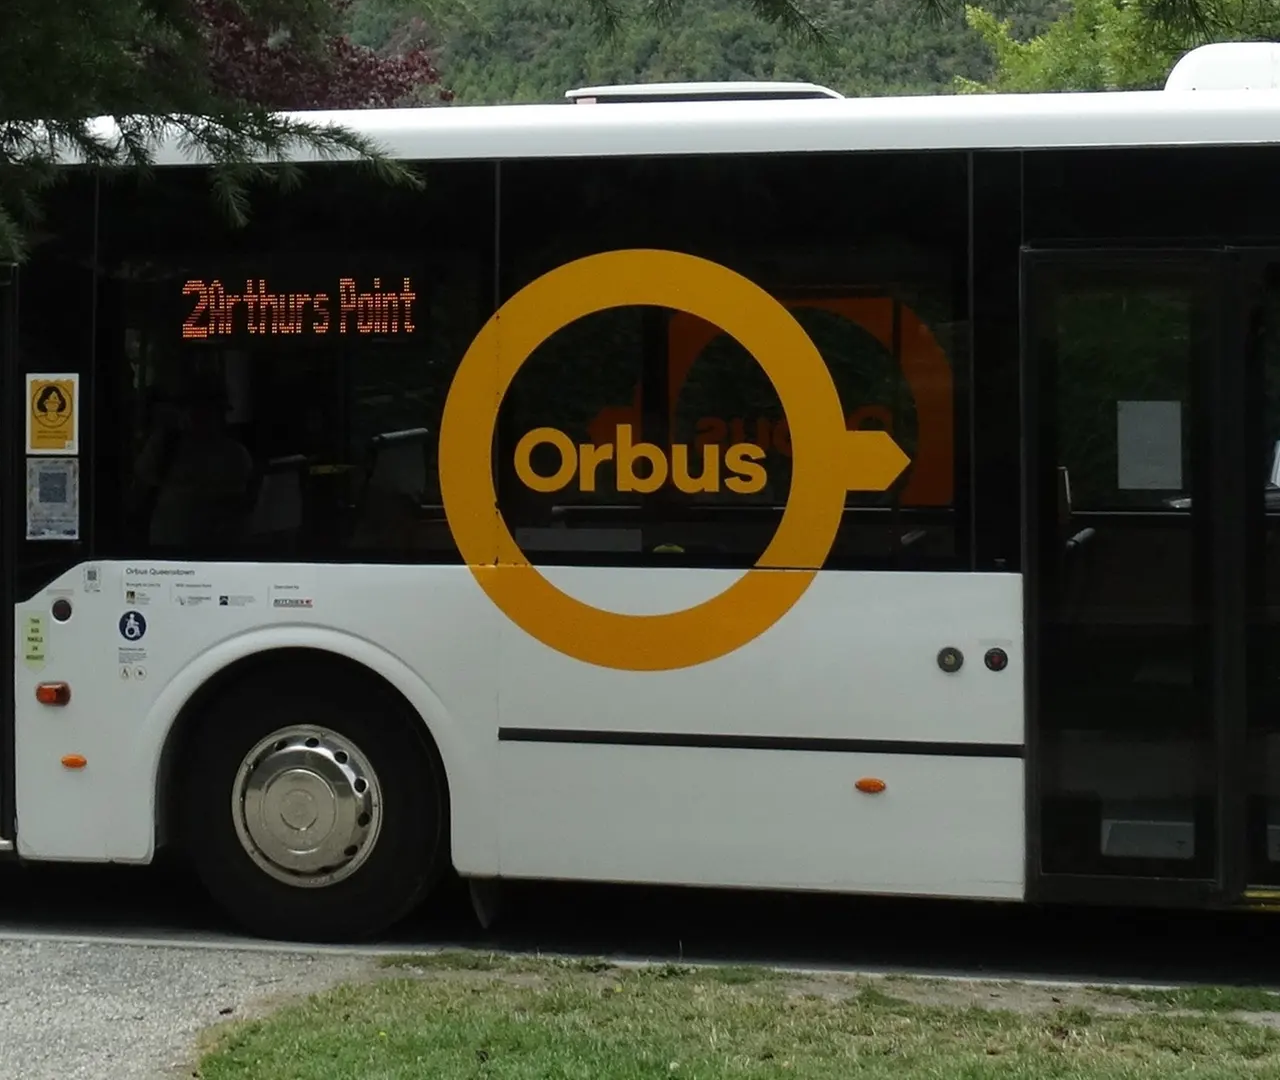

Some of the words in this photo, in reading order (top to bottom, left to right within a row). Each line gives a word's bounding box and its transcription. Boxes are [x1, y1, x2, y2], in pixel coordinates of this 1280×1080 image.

[208, 278, 330, 334] Arthurs
[338, 276, 417, 333] Point
[513, 423, 768, 496] Orbus
